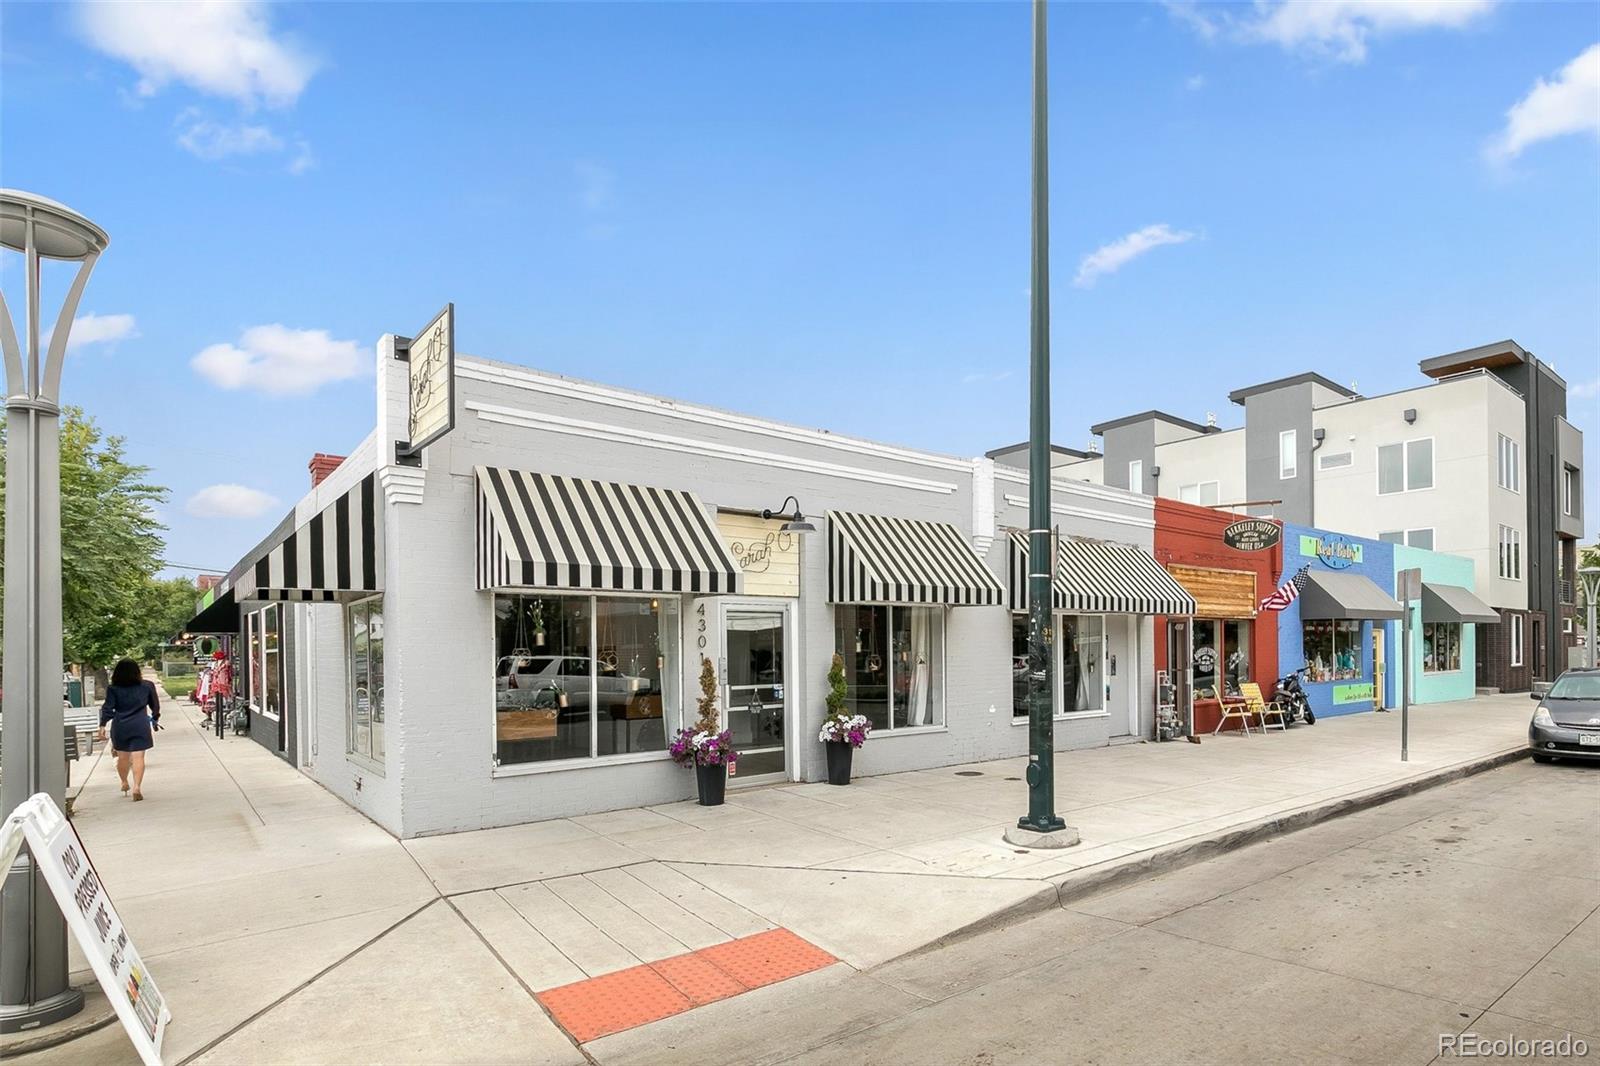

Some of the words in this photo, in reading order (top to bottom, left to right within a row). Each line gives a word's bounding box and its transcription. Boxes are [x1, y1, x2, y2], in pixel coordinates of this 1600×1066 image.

[1226, 522, 1255, 537] BERKELEY
[1256, 522, 1278, 536] SUPPLY
[1316, 539, 1334, 557] Real
[1337, 542, 1356, 561] Baby
[61, 844, 80, 880] COLD
[74, 868, 99, 920] PRESSED
[93, 901, 112, 944] JUICE
